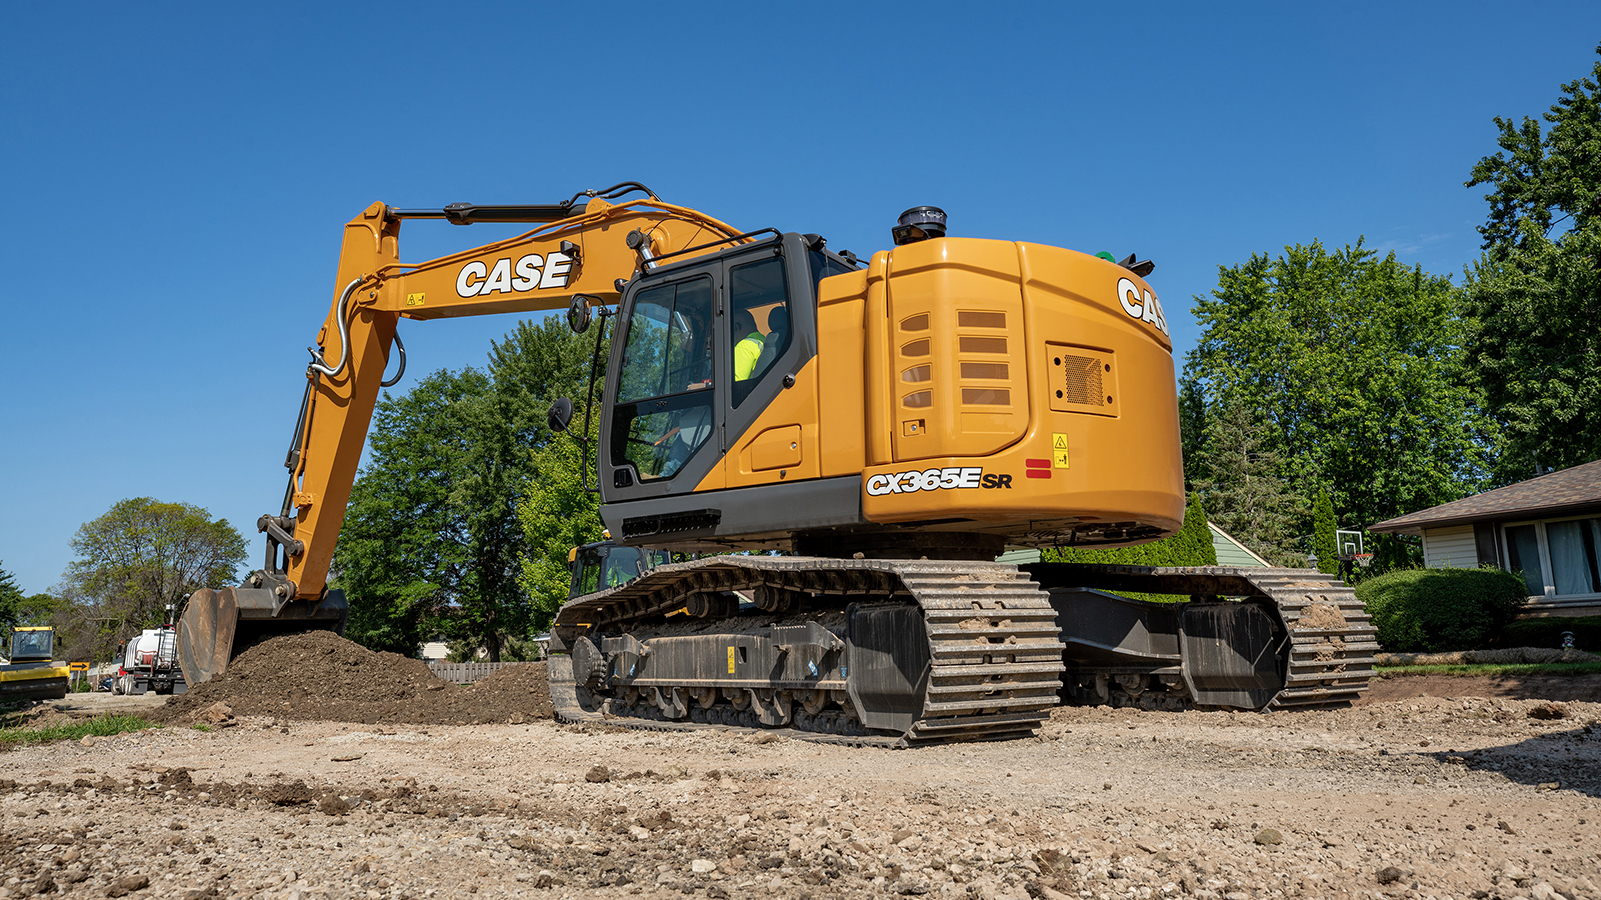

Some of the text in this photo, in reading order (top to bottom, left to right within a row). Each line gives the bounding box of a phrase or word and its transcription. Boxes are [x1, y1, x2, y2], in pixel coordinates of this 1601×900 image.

[456, 252, 573, 298] CASE
[1117, 277, 1170, 338] CAS
[982, 474, 1012, 489] SR
